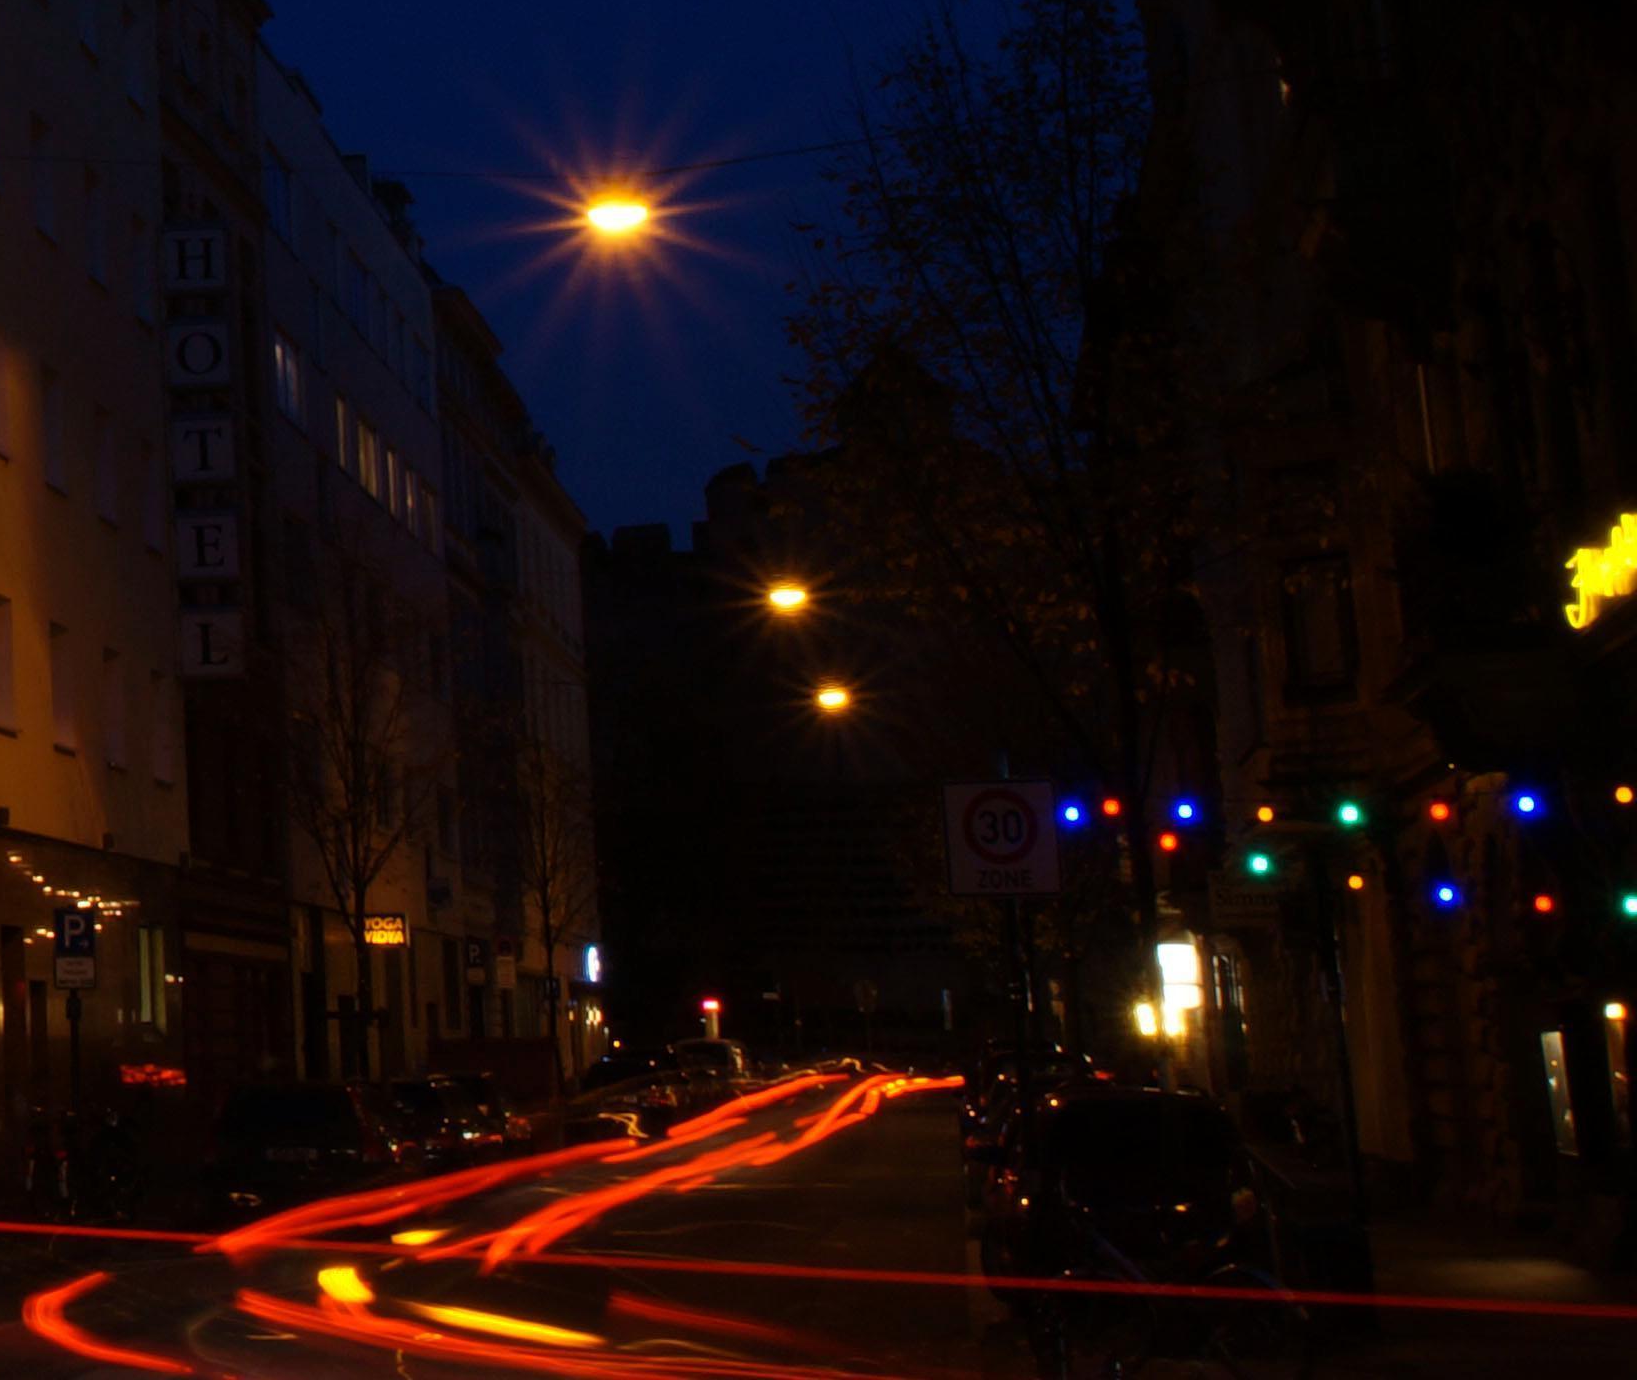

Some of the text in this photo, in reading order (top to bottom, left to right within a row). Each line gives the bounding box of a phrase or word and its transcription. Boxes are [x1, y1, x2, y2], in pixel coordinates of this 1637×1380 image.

[173, 238, 229, 667] HOTEL
[979, 809, 1024, 844] 30
[977, 868, 1032, 890] ZONE
[64, 914, 86, 949] P
[364, 916, 403, 930] YOGA
